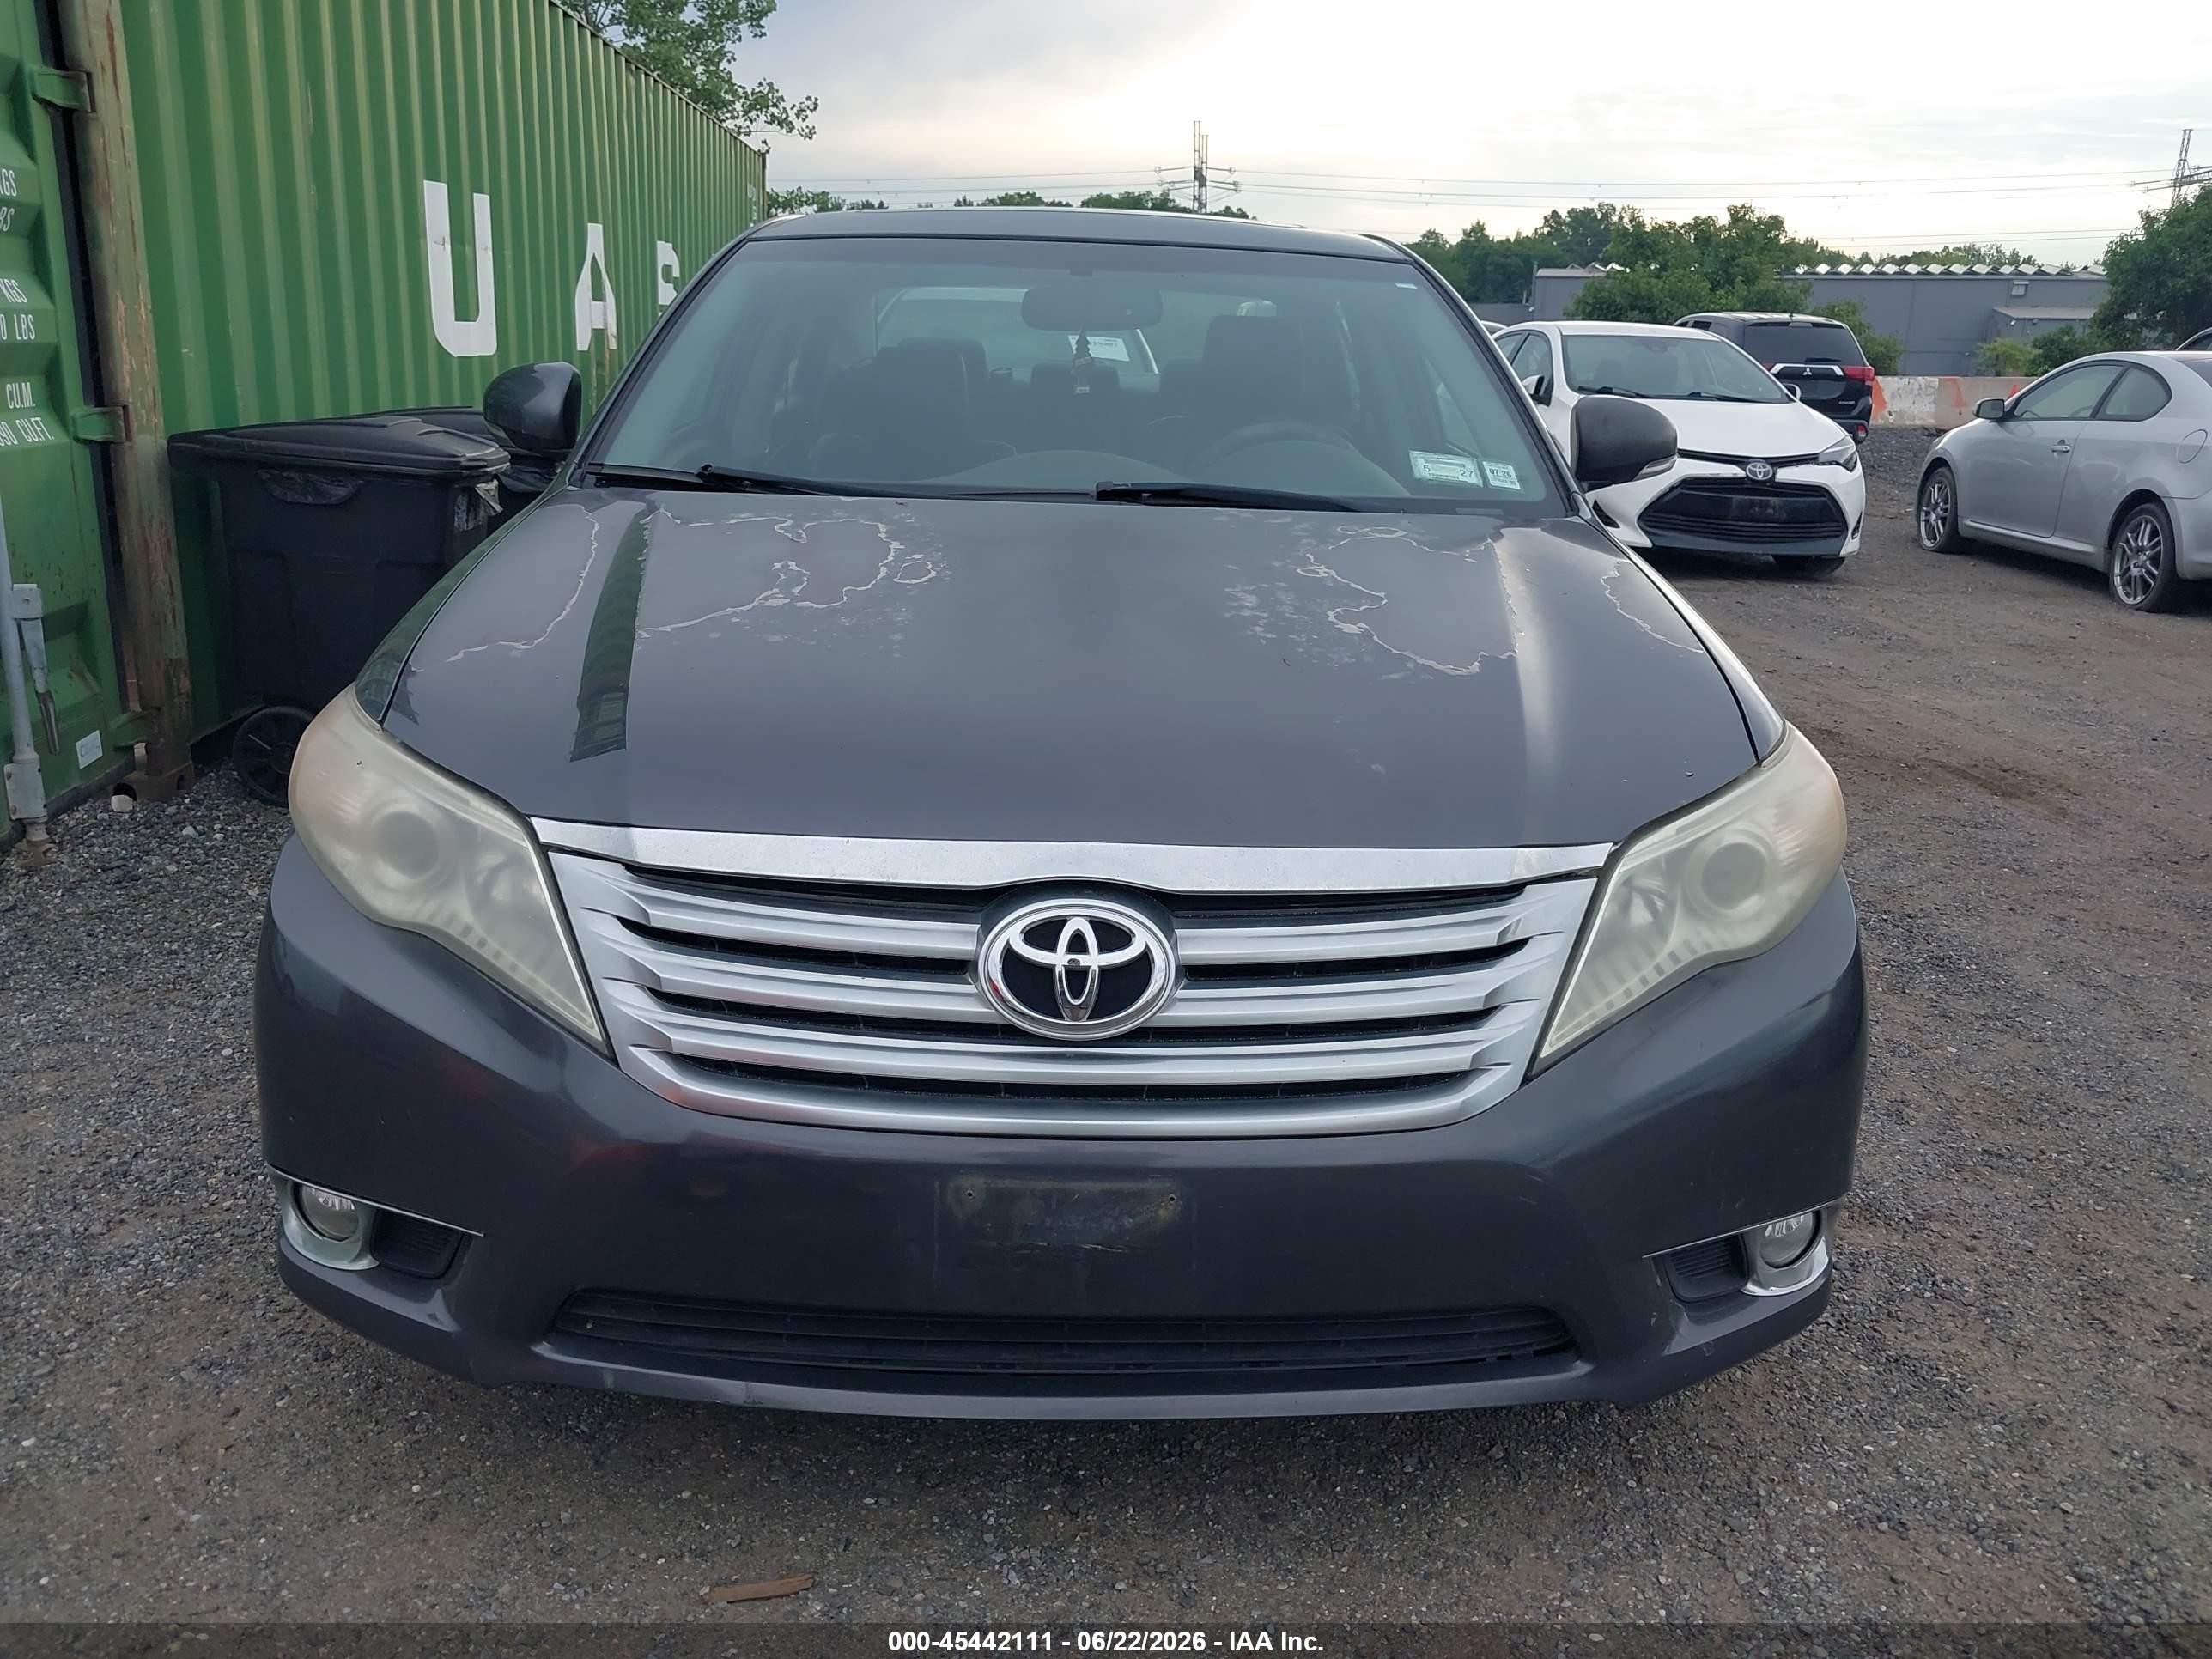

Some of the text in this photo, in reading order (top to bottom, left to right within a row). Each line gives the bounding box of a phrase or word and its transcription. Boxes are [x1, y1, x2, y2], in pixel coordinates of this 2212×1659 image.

[0, 168, 17, 197] GS
[14, 313, 35, 340] LBS
[6, 382, 36, 410] CU.M.
[0, 416, 55, 447] 90 CU.FT.
[1423, 465, 1431, 473] 5
[1459, 469, 1474, 478] 27
